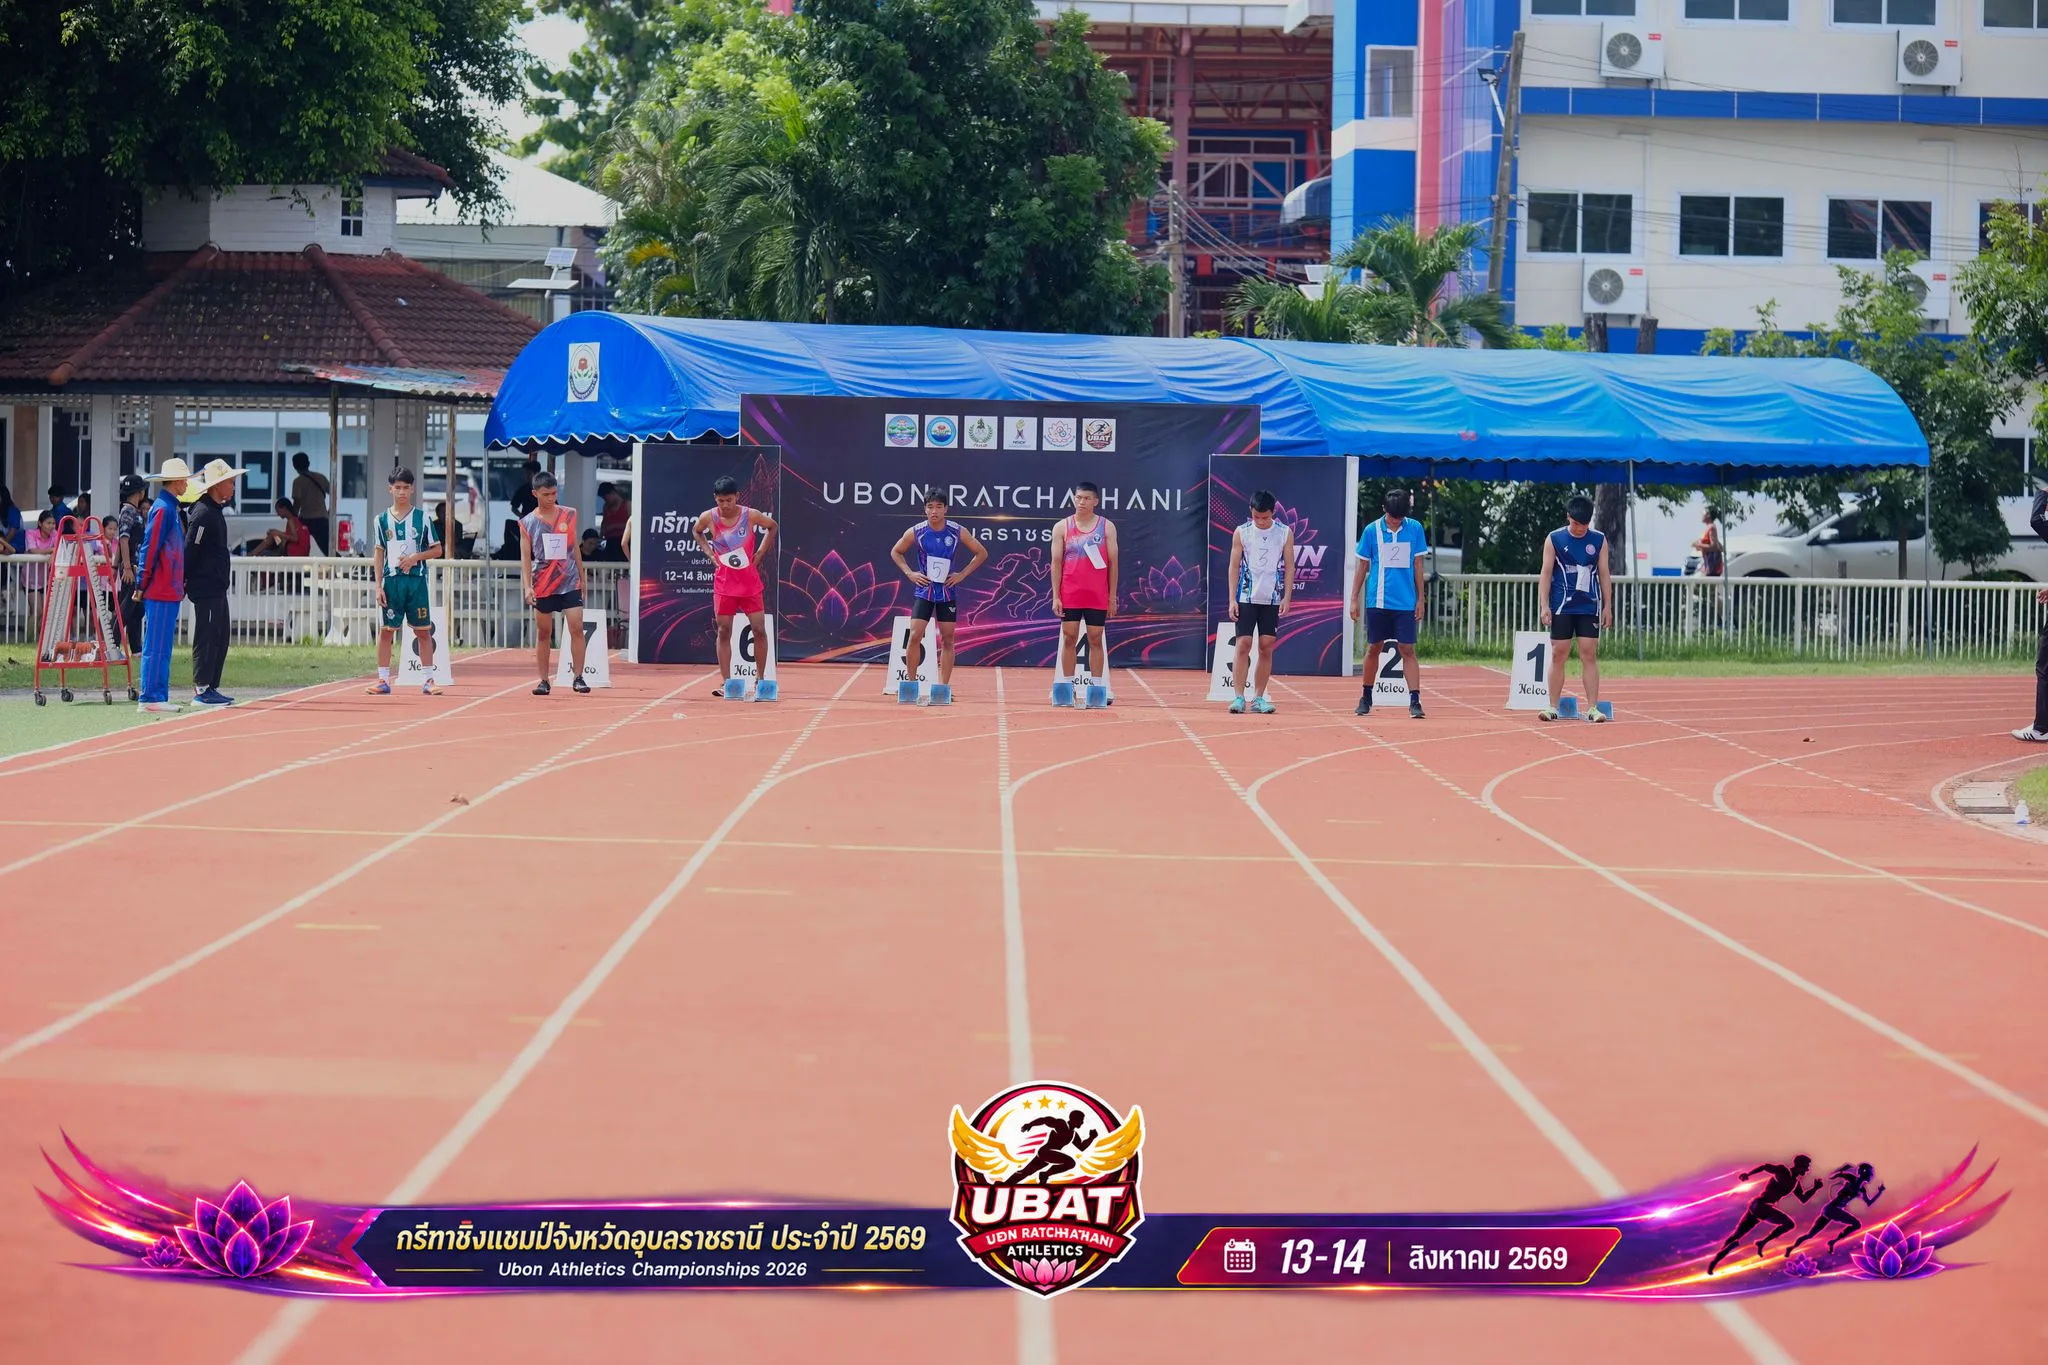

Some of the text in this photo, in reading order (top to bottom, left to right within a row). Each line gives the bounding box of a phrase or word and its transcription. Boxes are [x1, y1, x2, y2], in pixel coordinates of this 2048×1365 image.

[823, 481, 1181, 511] UBON RATCHAHANI
[549, 539, 561, 552] 7
[1390, 545, 1400, 561] 2
[728, 554, 742, 568] 6
[1256, 548, 1269, 567] 3
[932, 561, 943, 579] 5
[417, 608, 427, 619] 13
[1380, 640, 1404, 679] 2
[1527, 643, 1545, 682] 1
[734, 664, 757, 677] Nelc
